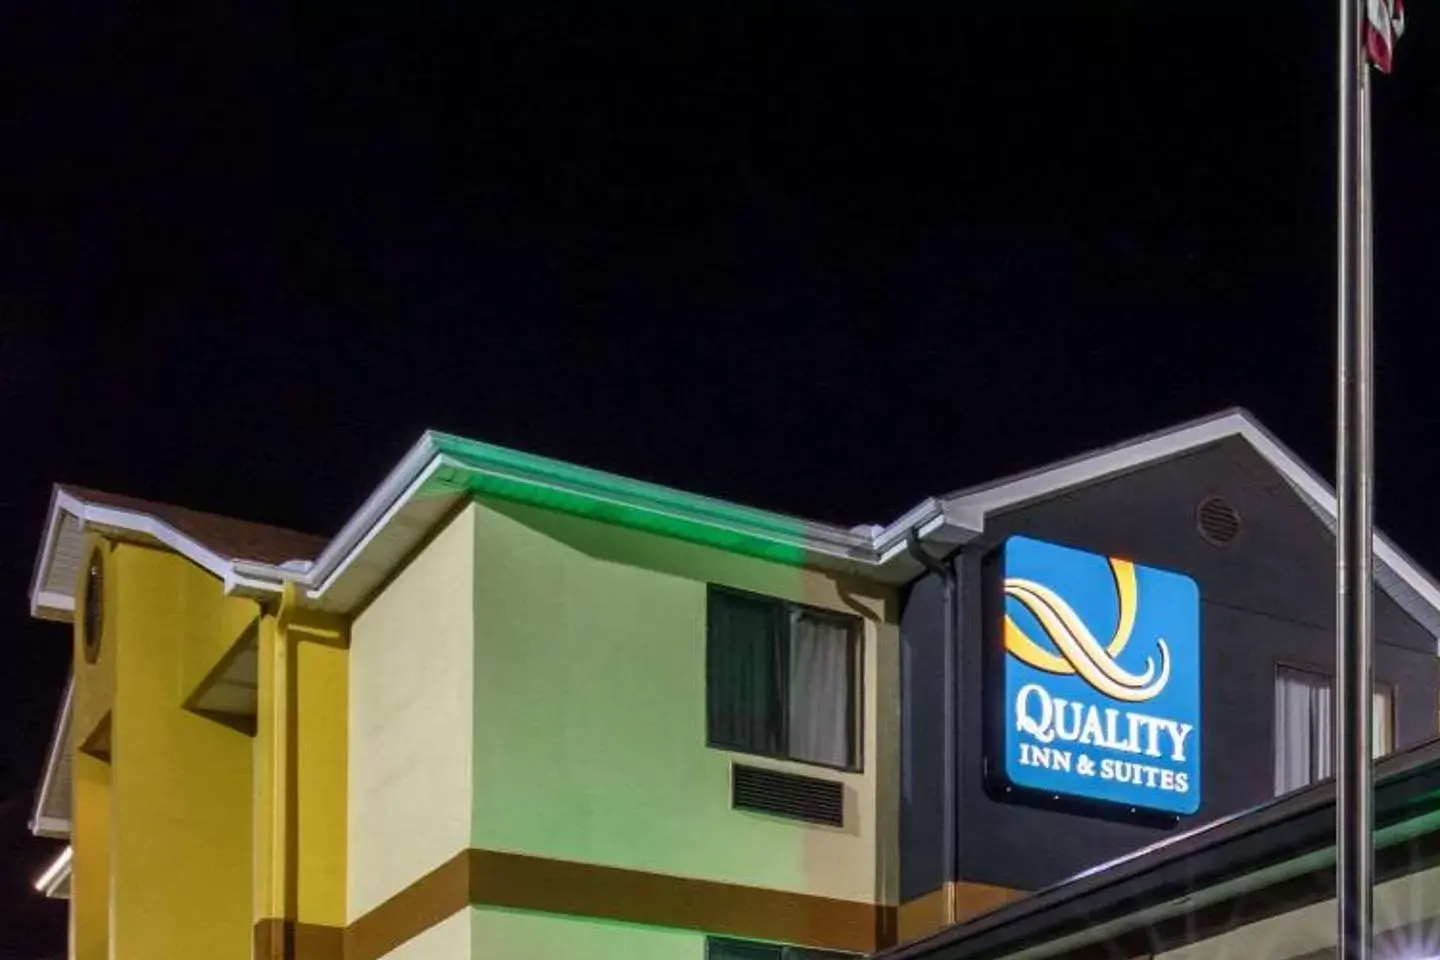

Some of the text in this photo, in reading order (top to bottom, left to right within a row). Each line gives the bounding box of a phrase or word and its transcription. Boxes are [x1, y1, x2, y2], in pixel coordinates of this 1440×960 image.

[1015, 684, 1194, 762] QUALITY
[1018, 743, 1189, 793] INN & SUITES
